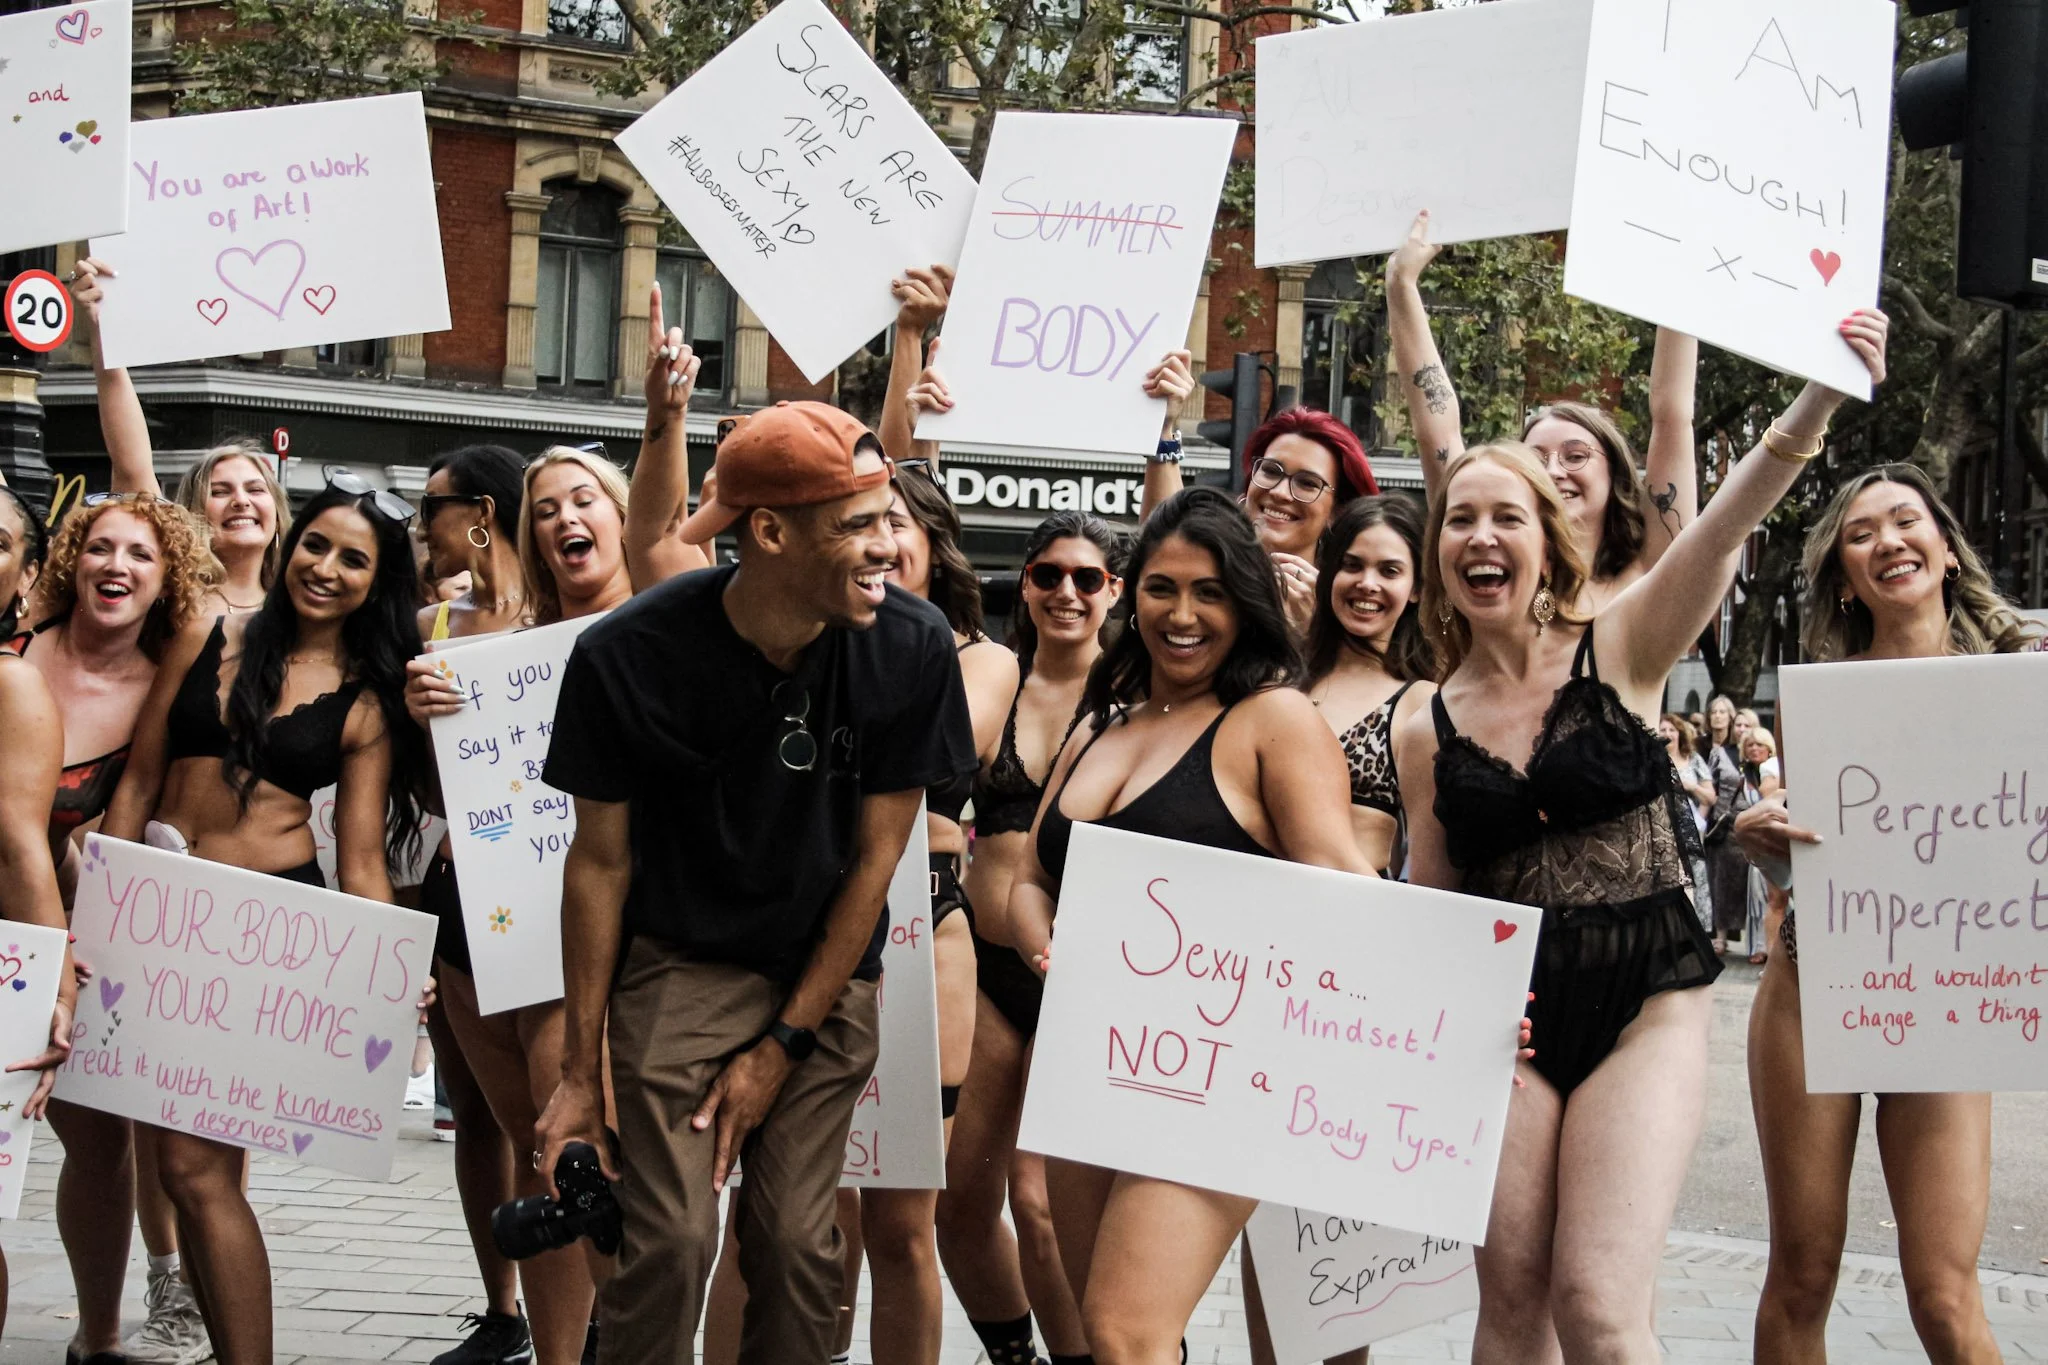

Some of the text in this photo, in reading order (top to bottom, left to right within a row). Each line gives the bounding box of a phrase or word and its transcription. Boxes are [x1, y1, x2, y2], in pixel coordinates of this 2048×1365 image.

[28, 83, 70, 103] and
[776, 24, 943, 210] SCARS ARE
[133, 160, 202, 200] You
[223, 168, 266, 190] are
[783, 116, 890, 226] THE NEW
[1600, 81, 1846, 234] ENOUGH!
[208, 192, 312, 232] of Art!
[993, 176, 1178, 254] SUMMER
[17, 293, 63, 329] 20
[990, 297, 1160, 381] BODY
[506, 662, 552, 702] you
[458, 737, 500, 765] say
[508, 725, 526, 745] it
[467, 794, 568, 831] DONT say
[1837, 764, 2048, 865] Perfectly
[103, 870, 416, 1003] YOUR BODY IS
[1122, 877, 1249, 1027] Sexy
[1265, 945, 1293, 988] is
[1827, 878, 2048, 964] Imperfect
[1935, 963, 2048, 988] wouldn't
[142, 963, 359, 1059] YOUR HOME
[1283, 996, 1446, 1062] Mindset!
[1842, 998, 2042, 1046] change a thing
[135, 1046, 149, 1077] it
[228, 1075, 265, 1111] the
[1107, 1026, 1484, 1172] NOT a Body Type!
[193, 1107, 288, 1150] deserves
[1295, 1207, 1378, 1252] hav
[1309, 1235, 1460, 1306] Expiratio
